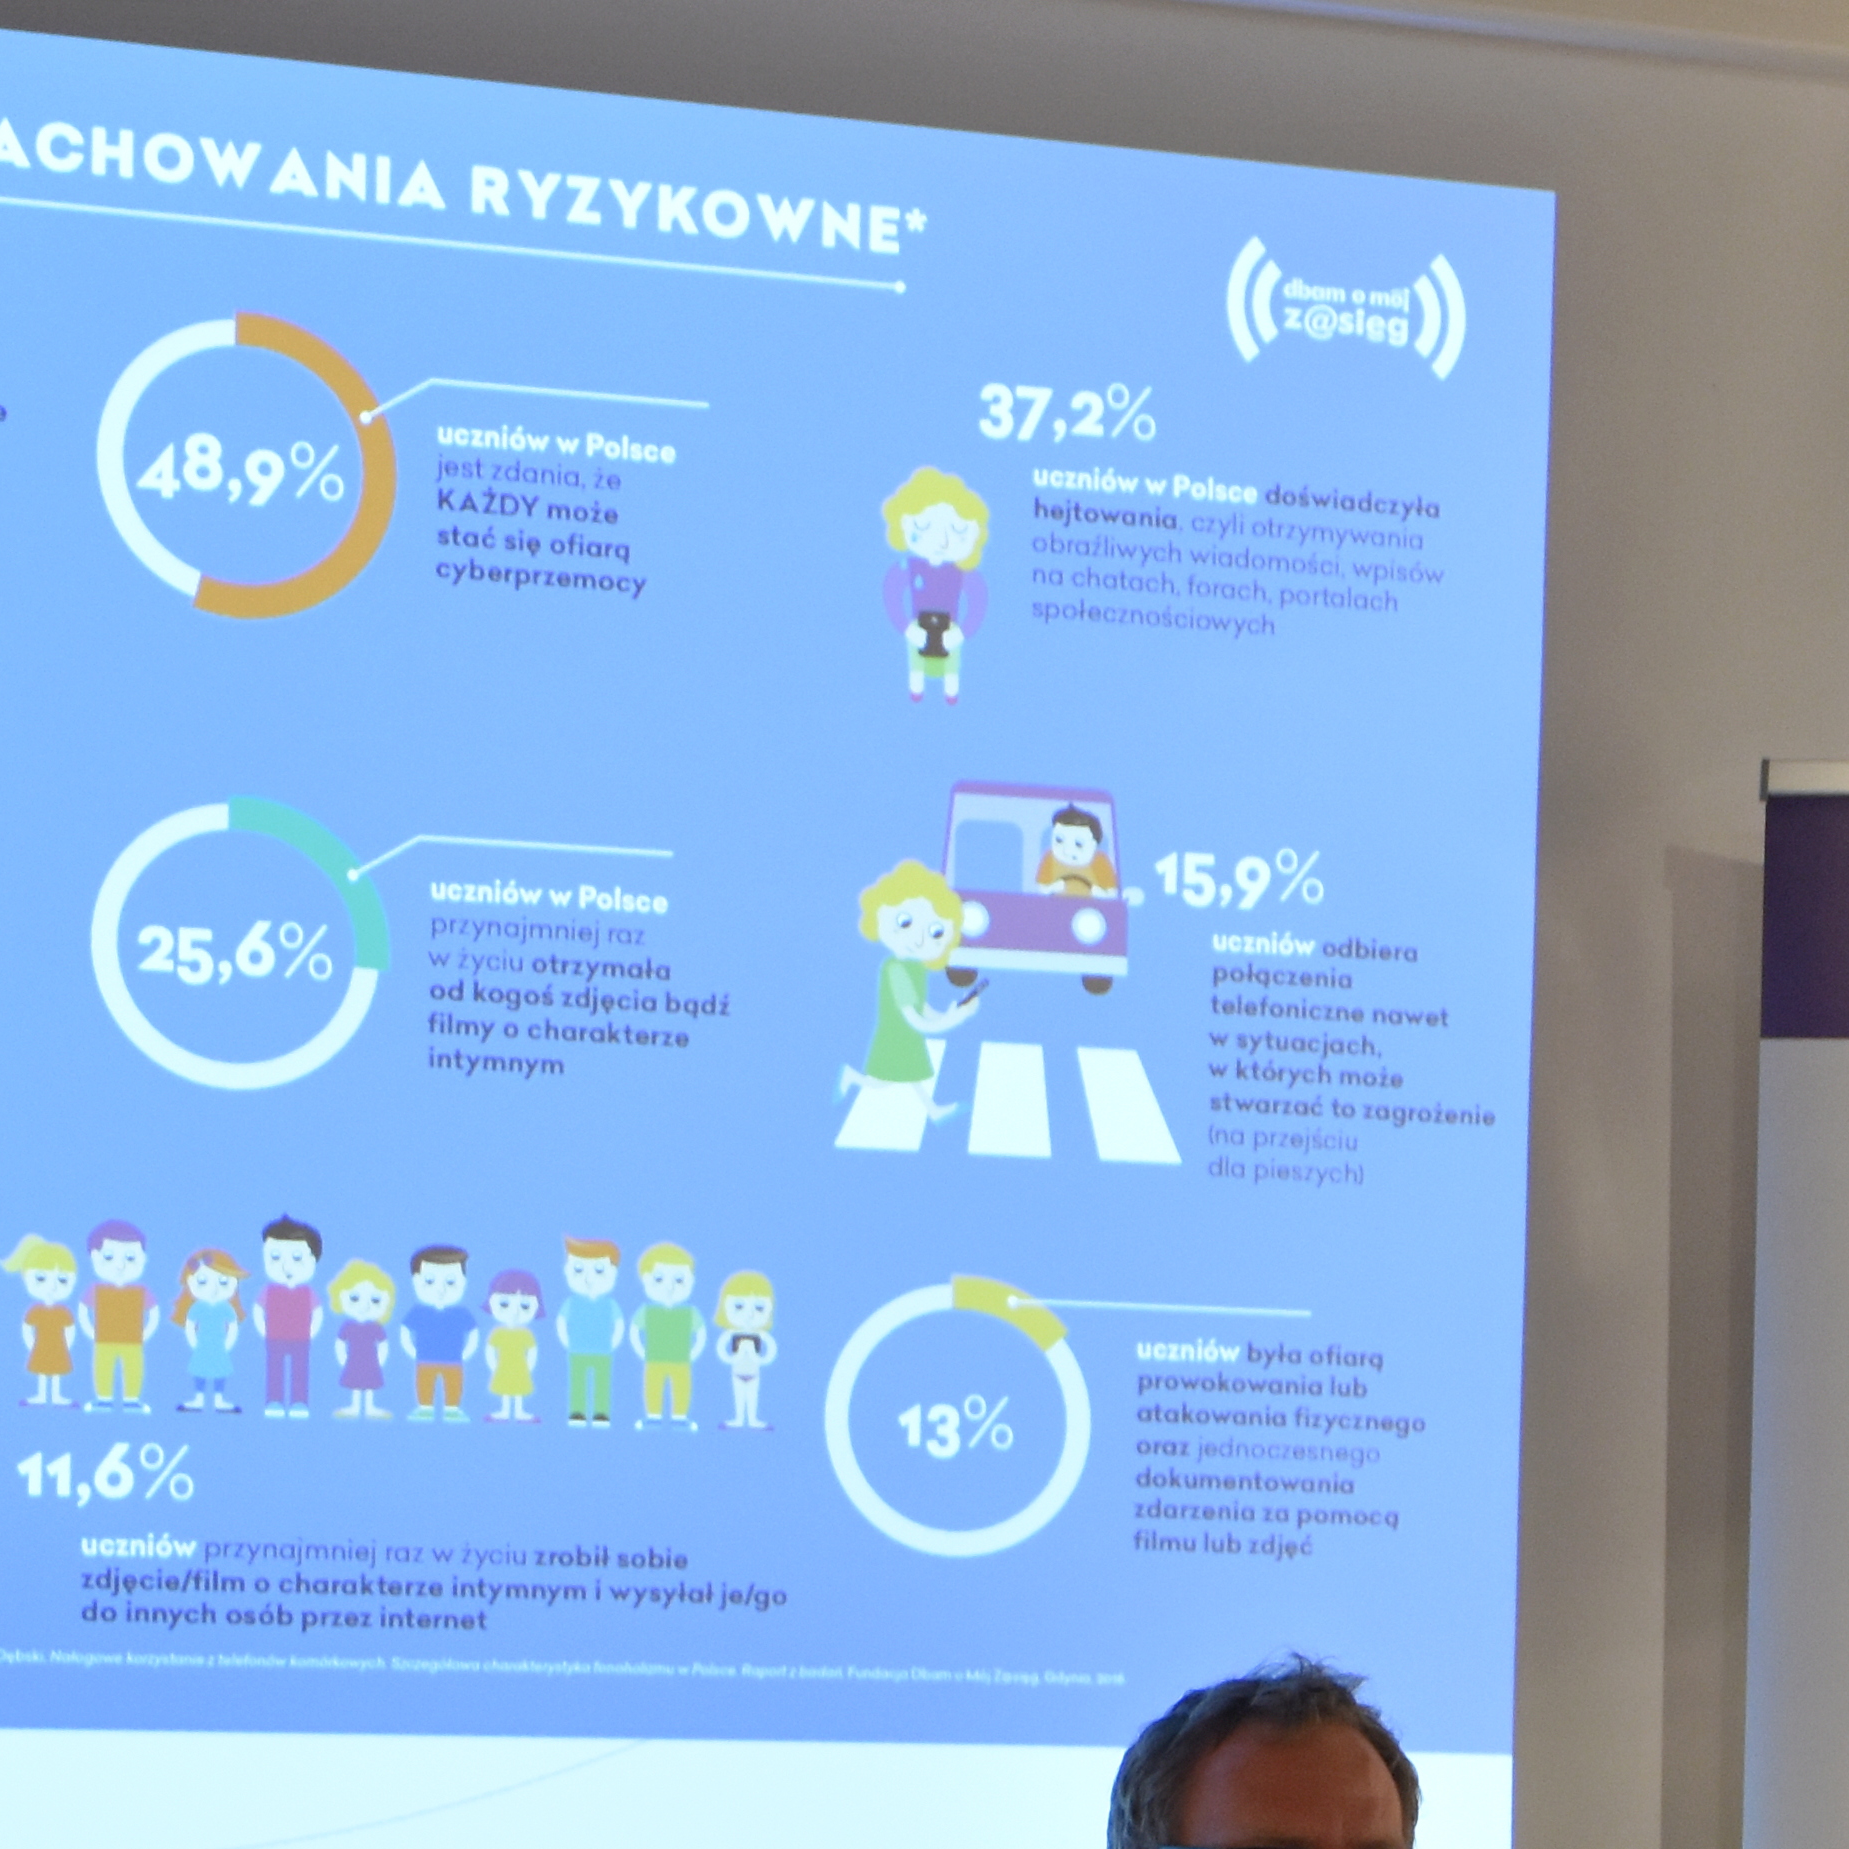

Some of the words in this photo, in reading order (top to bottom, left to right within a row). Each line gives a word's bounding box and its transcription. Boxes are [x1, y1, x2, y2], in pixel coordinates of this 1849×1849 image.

[1283, 277, 1347, 303] dbam
[1351, 288, 1367, 305] o
[1283, 303, 1410, 347] z@sieg
[977, 382, 1158, 444] 37,2%
[135, 430, 347, 507] 48,9%
[437, 424, 550, 452] uczniów
[555, 436, 580, 454] w
[585, 432, 677, 465] Polsce
[435, 454, 483, 484] jest
[491, 459, 586, 493] zdania,
[593, 467, 622, 491] że
[1032, 466, 1140, 494] uczniów
[1144, 477, 1168, 496] w
[1172, 473, 1259, 506] Polsce
[1264, 483, 1440, 523] doświadczyła
[437, 487, 539, 518] KAŻDY
[546, 500, 619, 526] może
[437, 525, 495, 550] stać
[504, 529, 542, 558] się
[549, 532, 631, 565] ofiarą
[435, 558, 647, 600] cyberprzemocy
[1152, 846, 1326, 911] 15,9%
[135, 917, 334, 987] 25,6%
[897, 1392, 1015, 1460] 13%
[15, 1441, 196, 1509] 11,6%
